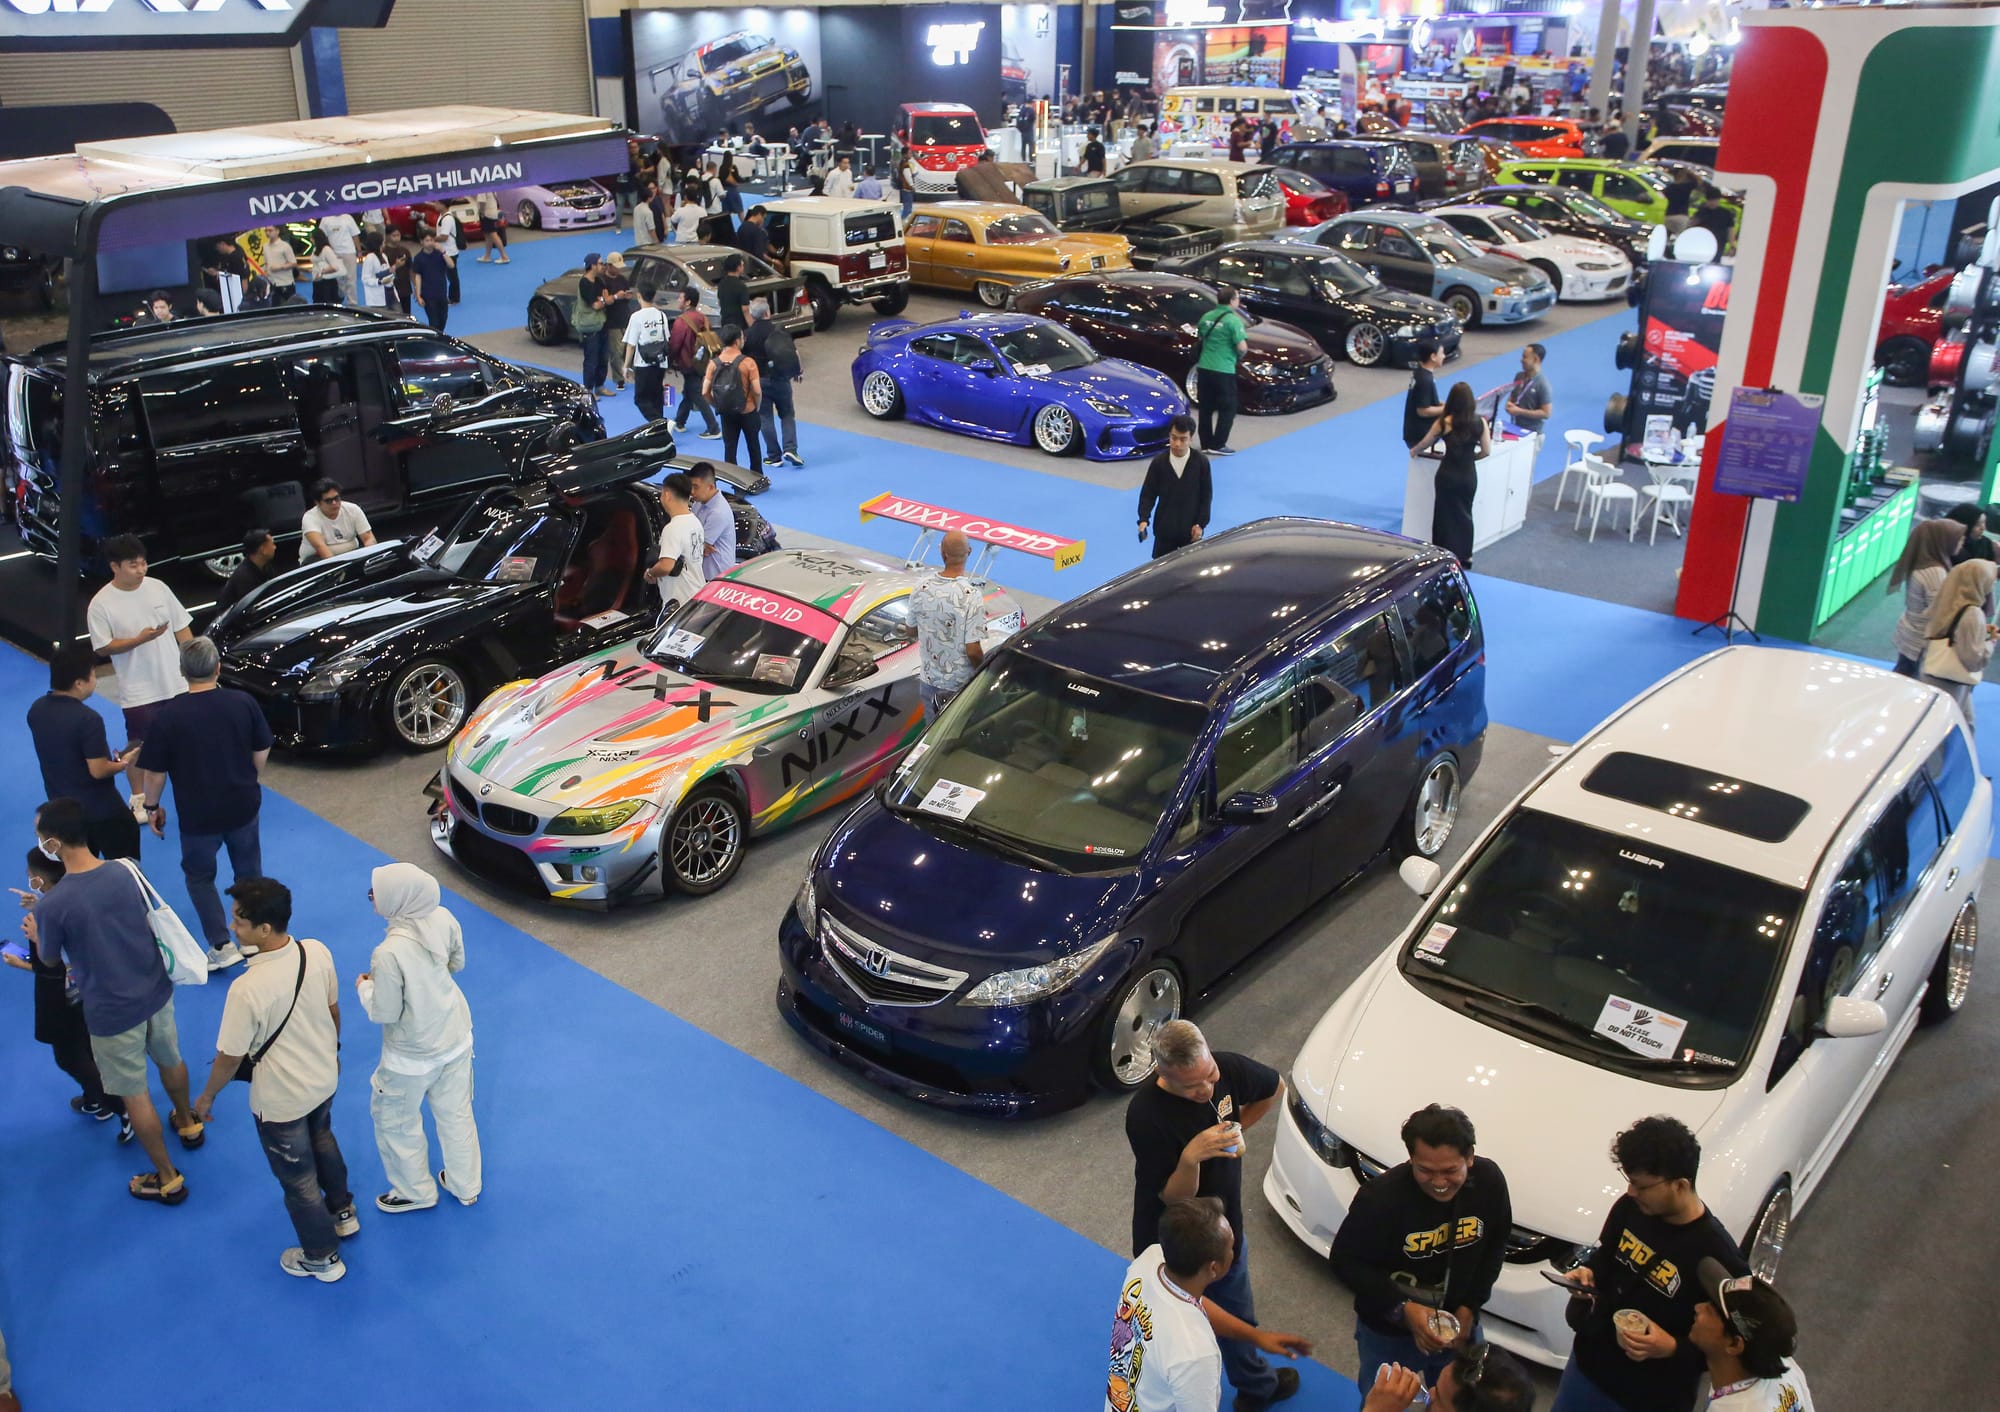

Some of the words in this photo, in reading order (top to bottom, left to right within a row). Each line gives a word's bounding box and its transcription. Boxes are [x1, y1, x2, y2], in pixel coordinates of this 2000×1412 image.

[249, 189, 320, 216] NIXX
[340, 174, 434, 202] GOFAR
[436, 161, 523, 189] HILMAN
[483, 507, 515, 523] NIXX
[785, 551, 872, 576] XCAPE
[794, 562, 843, 577] NIXX
[1061, 554, 1081, 569] NIXX
[712, 586, 804, 623] NIXX.CO.ID
[578, 659, 739, 723] NIXX
[781, 683, 902, 788] NIXX
[1608, 1024, 1618, 1033] DO
[1619, 1030, 1636, 1040] NOT
[1638, 1036, 1663, 1049] TOUCH
[1625, 1024, 1650, 1036] PLEASE
